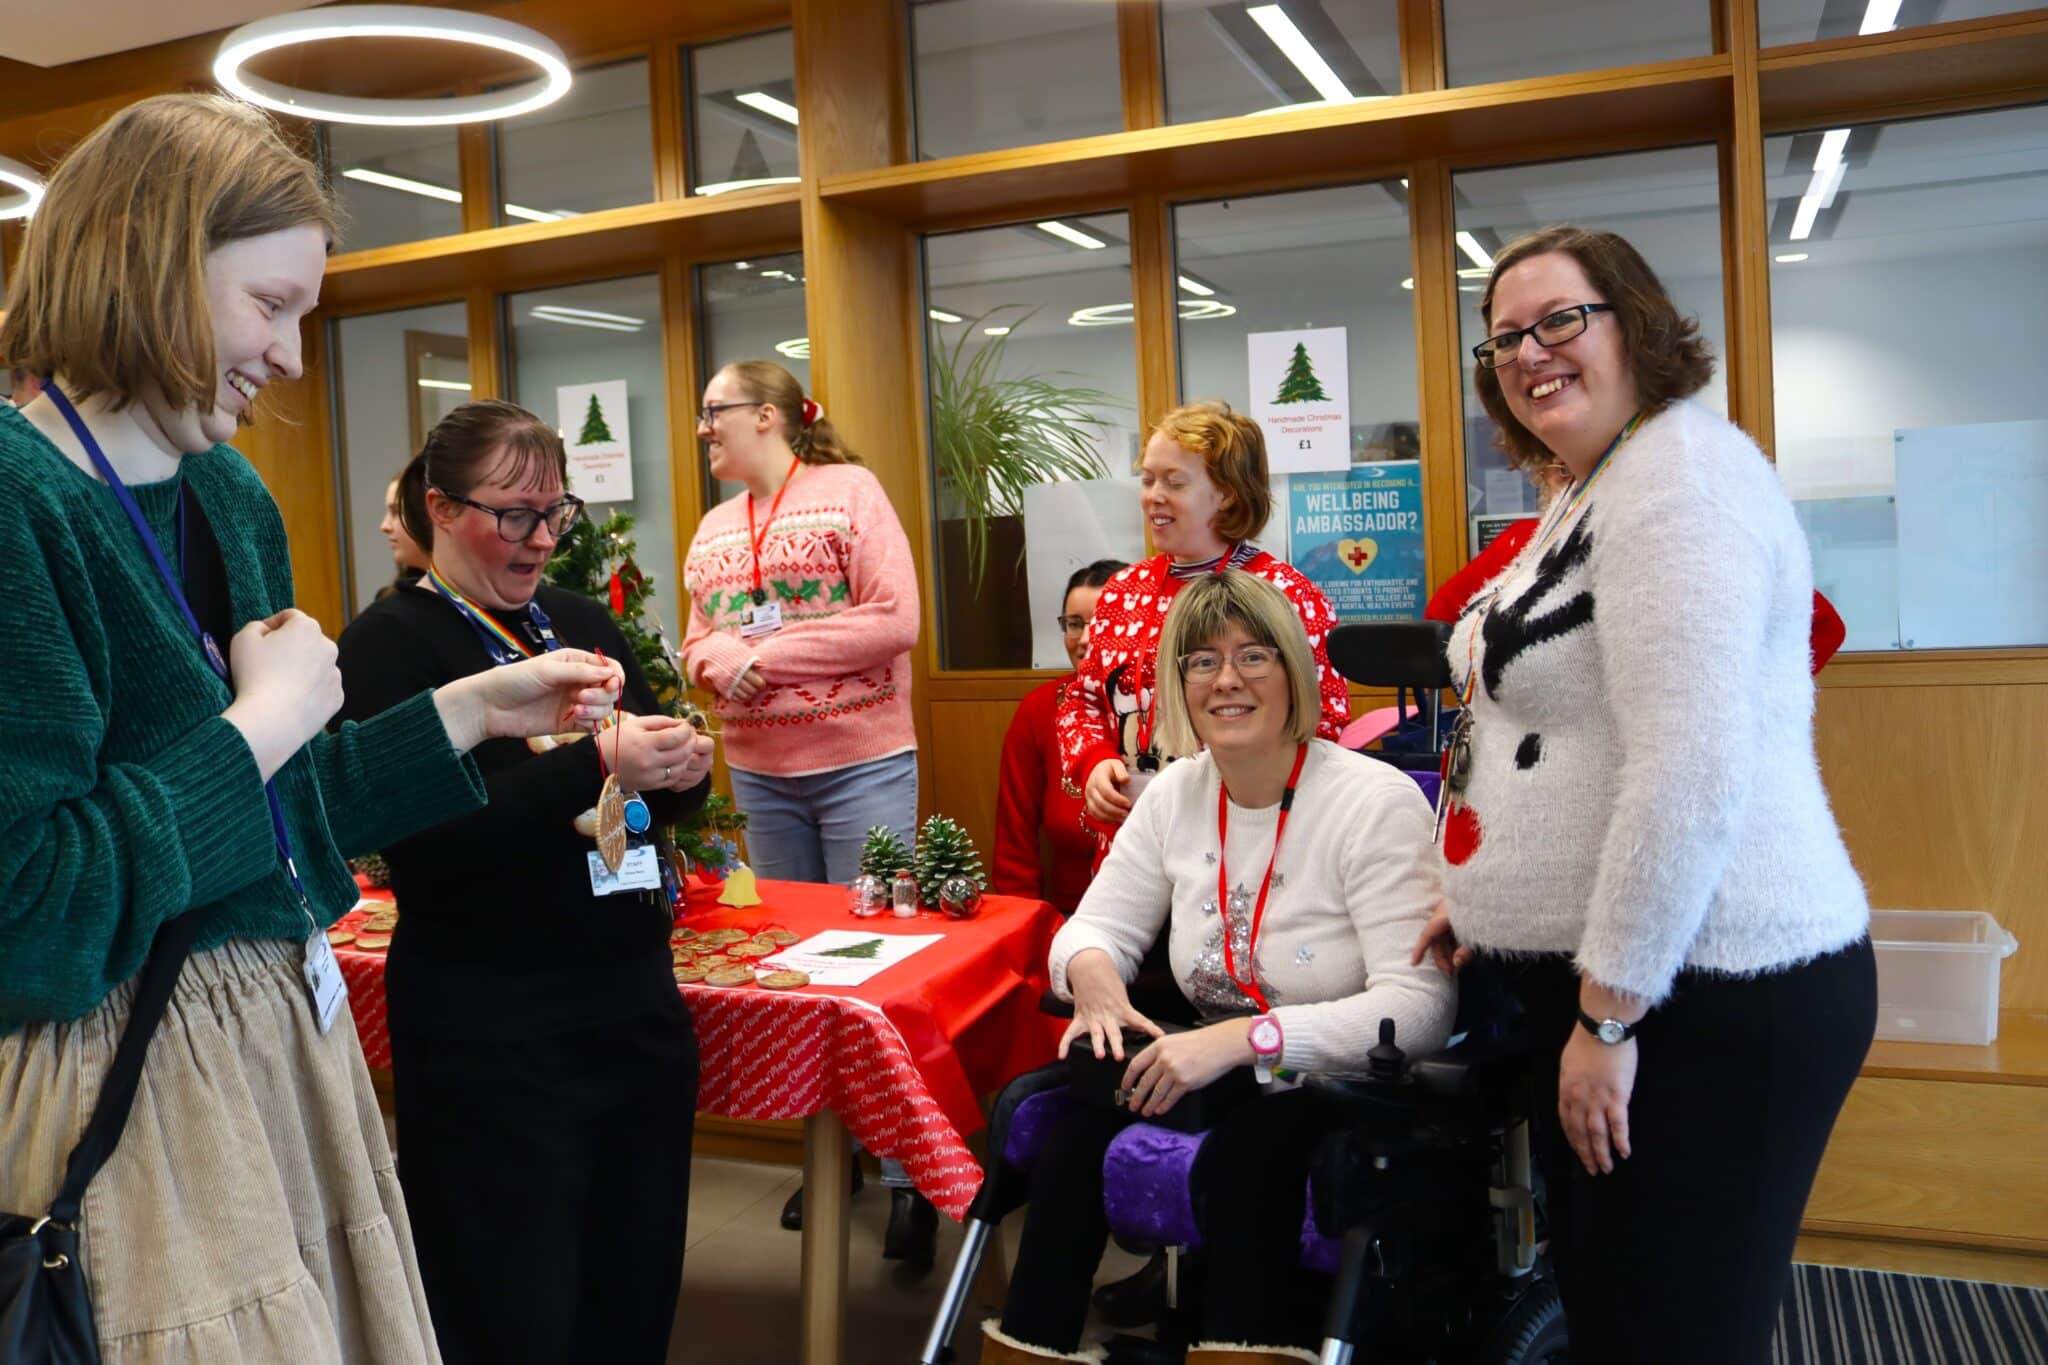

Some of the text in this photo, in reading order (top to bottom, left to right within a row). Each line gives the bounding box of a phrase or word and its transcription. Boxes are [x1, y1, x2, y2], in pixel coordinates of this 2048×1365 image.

[1299, 439, 1311, 449] £1
[1306, 491, 1400, 512] WELLBEING
[1296, 511, 1418, 534] AMBASSADOR?
